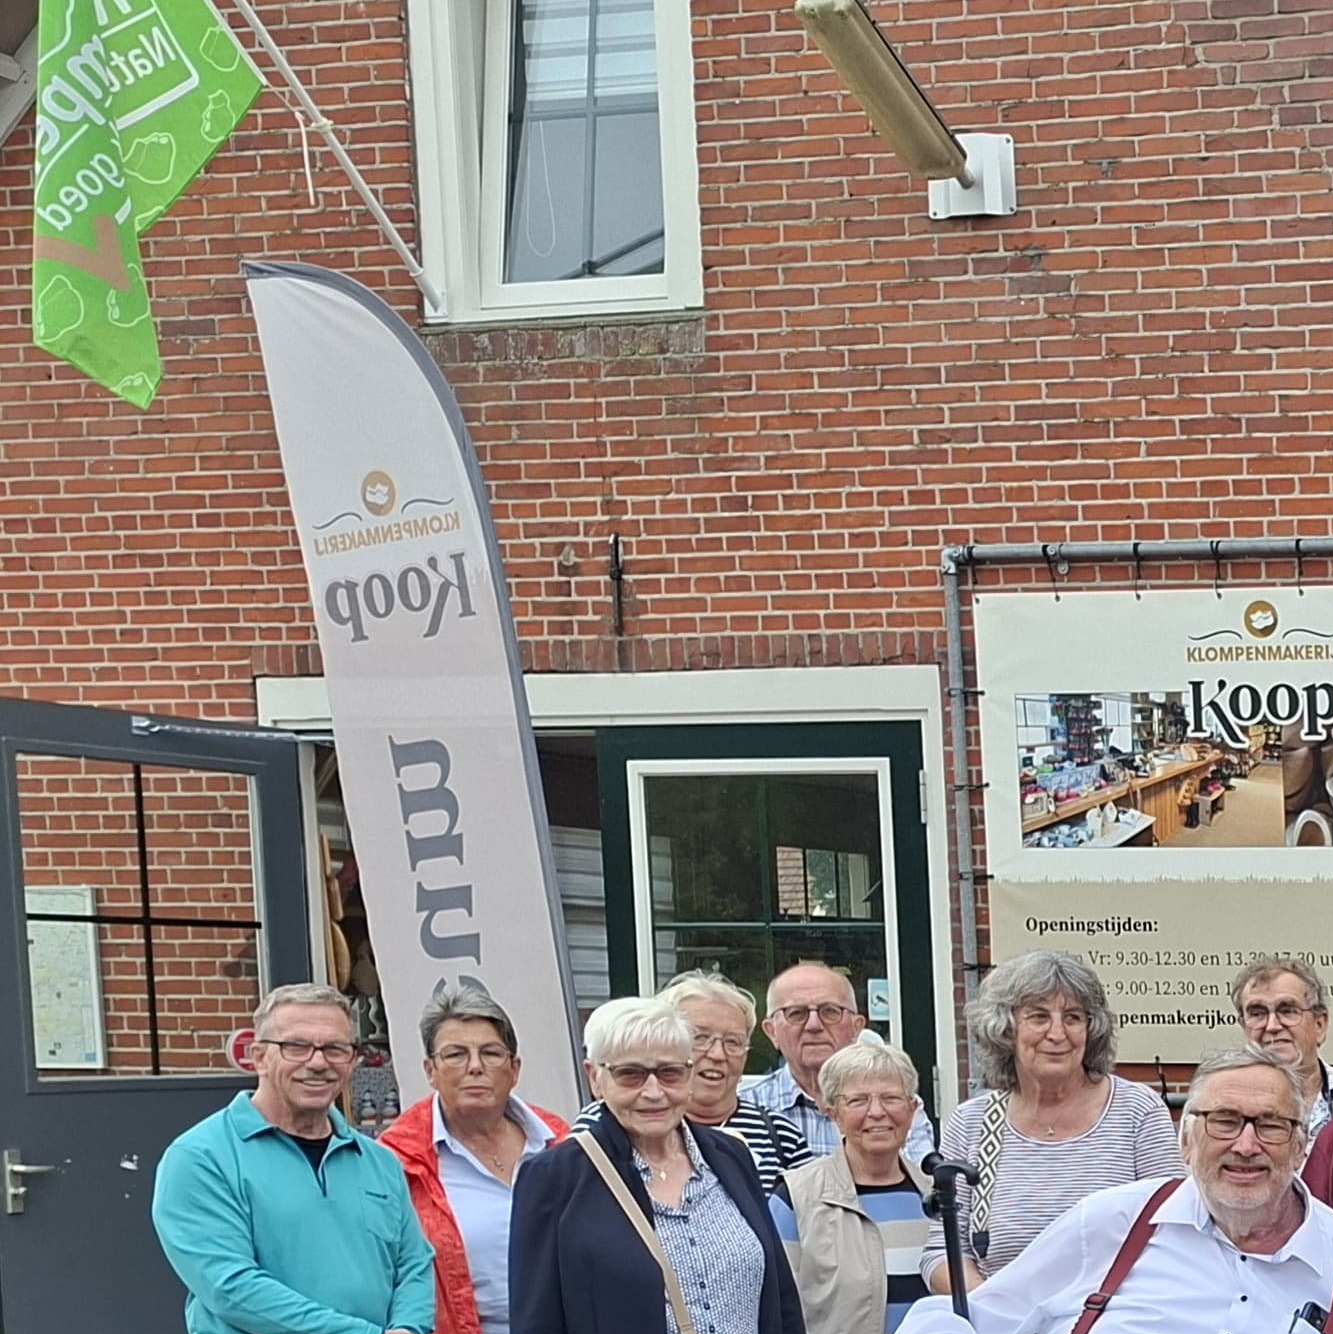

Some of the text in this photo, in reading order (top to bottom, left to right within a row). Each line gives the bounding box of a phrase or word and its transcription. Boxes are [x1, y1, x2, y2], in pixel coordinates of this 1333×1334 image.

[1025, 915, 1159, 936] Openingstijden:
[1087, 950, 1111, 966] Vr:
[1115, 950, 1197, 966] 9.30-12.30
[1200, 953, 1220, 966] en
[1115, 980, 1196, 996] 9.00-12.30
[1200, 983, 1220, 996] en
